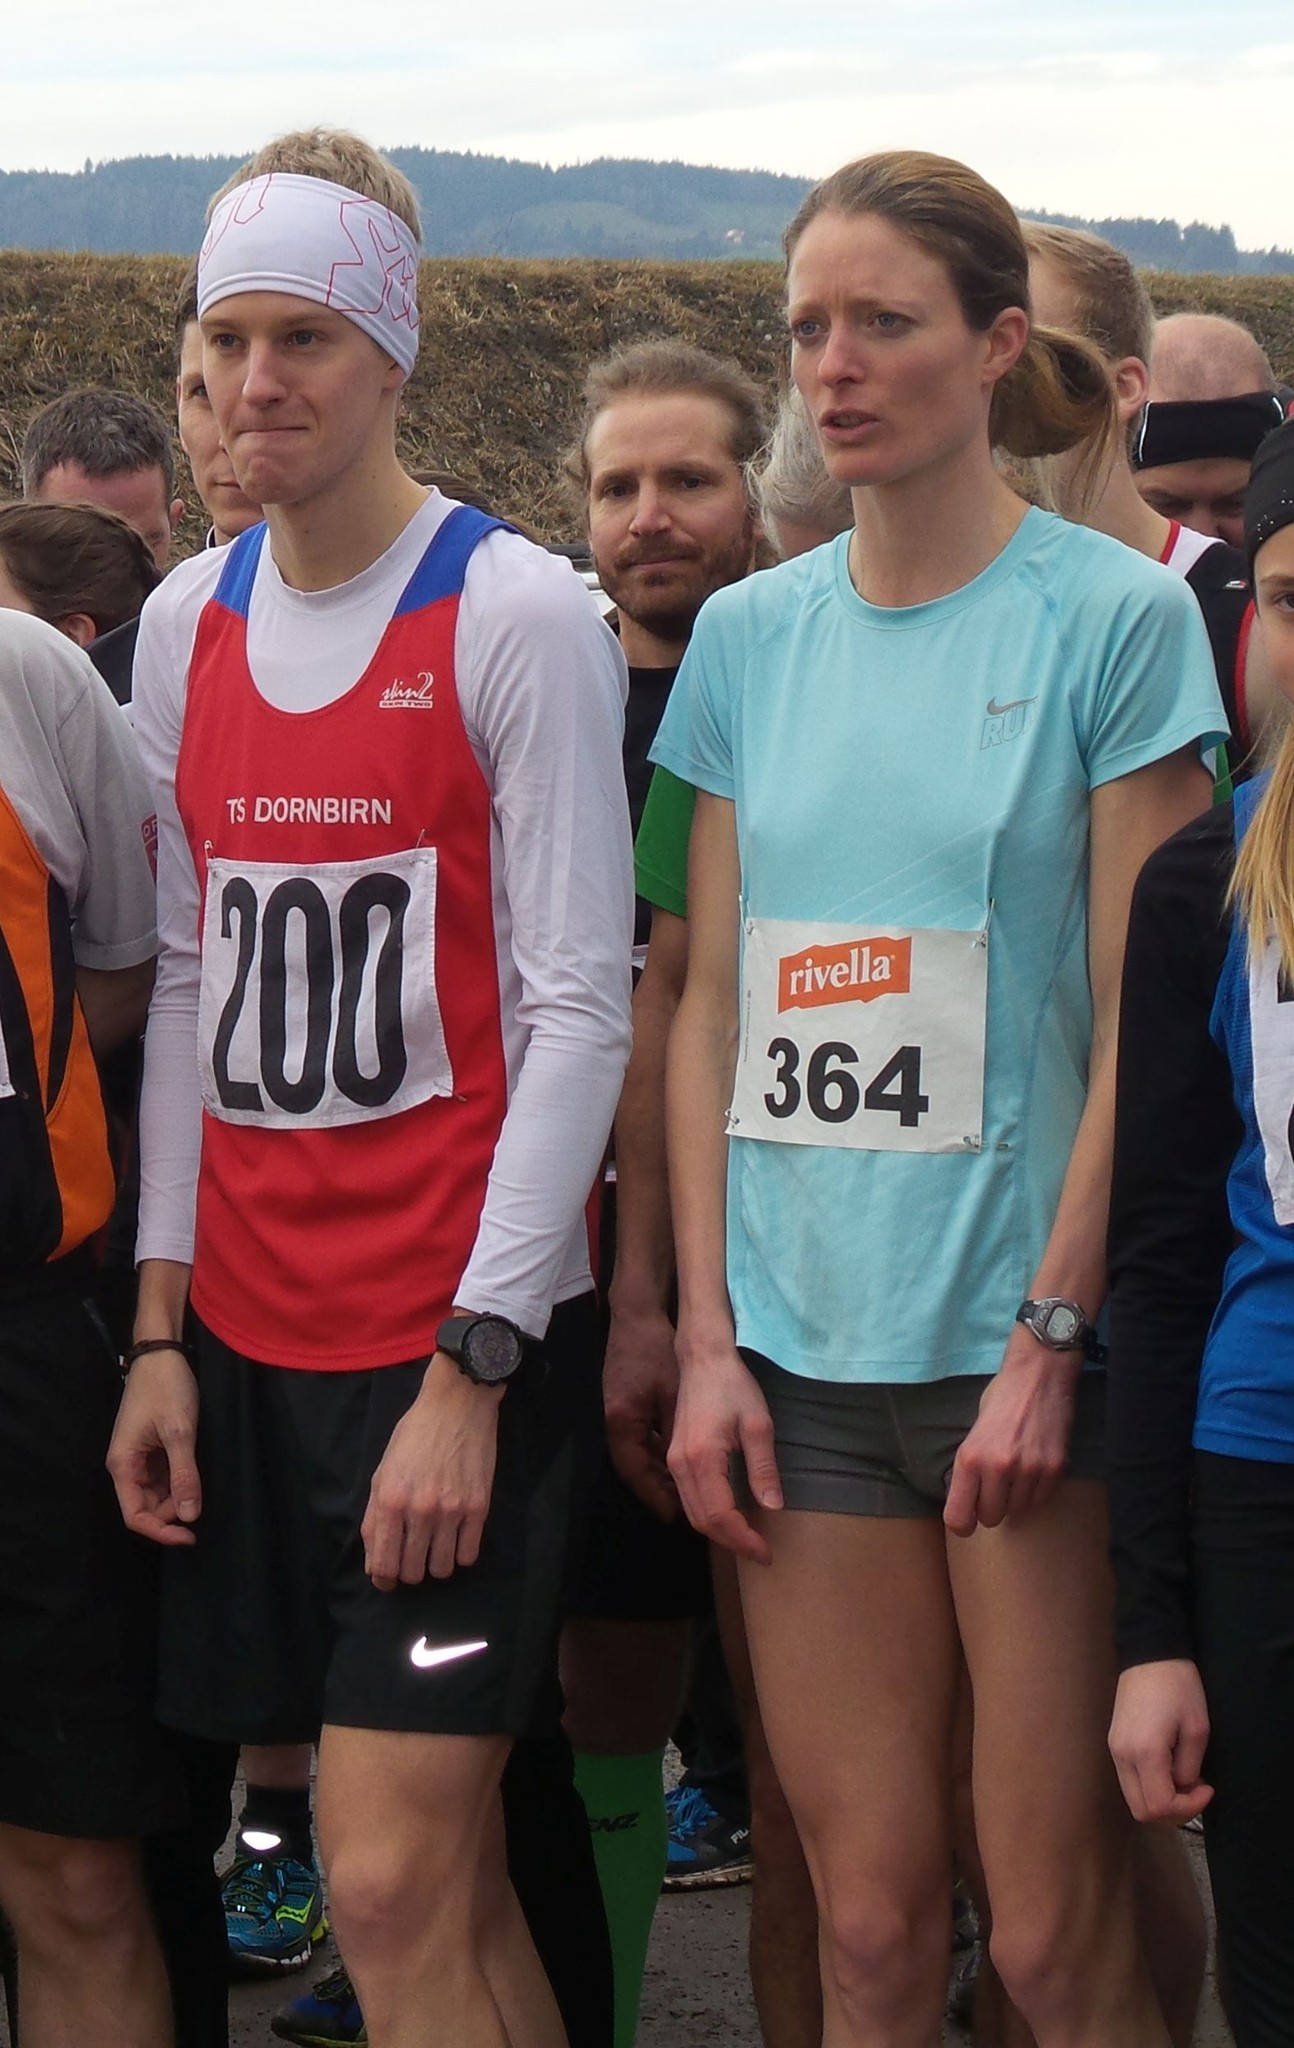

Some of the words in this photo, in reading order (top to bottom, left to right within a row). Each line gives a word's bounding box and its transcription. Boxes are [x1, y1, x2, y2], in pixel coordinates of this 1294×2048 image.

[980, 703, 1037, 750] RU
[227, 797, 246, 824] TS
[254, 797, 392, 825] DORNBIRN
[212, 872, 411, 1114] 200
[790, 945, 892, 996] rivella
[764, 1037, 929, 1127] 364
[730, 1828, 750, 1845] FIL
